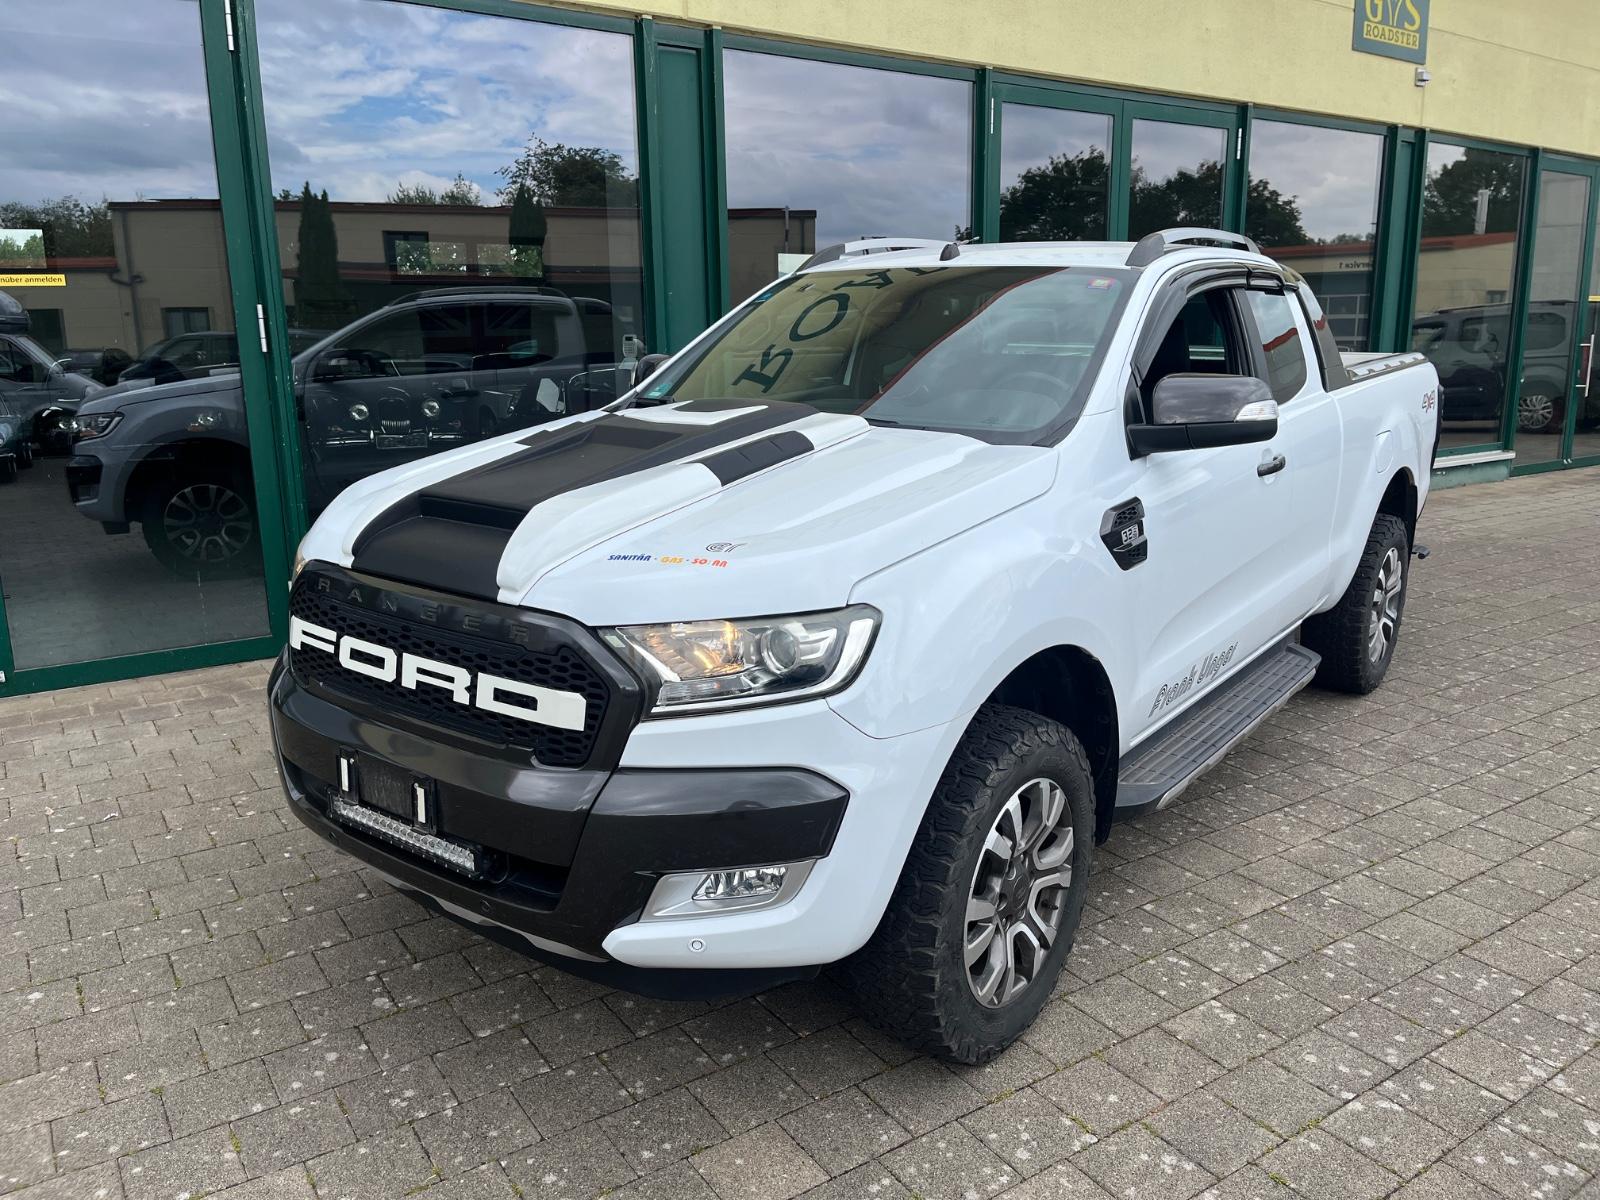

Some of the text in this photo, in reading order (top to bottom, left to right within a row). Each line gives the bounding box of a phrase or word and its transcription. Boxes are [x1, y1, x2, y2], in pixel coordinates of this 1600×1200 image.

[1365, 23, 1418, 47] ROADSTER
[660, 556, 683, 564] GAS
[691, 558, 728, 568] SOAR
[318, 577, 530, 644] RANGER
[289, 614, 587, 732] FORD
